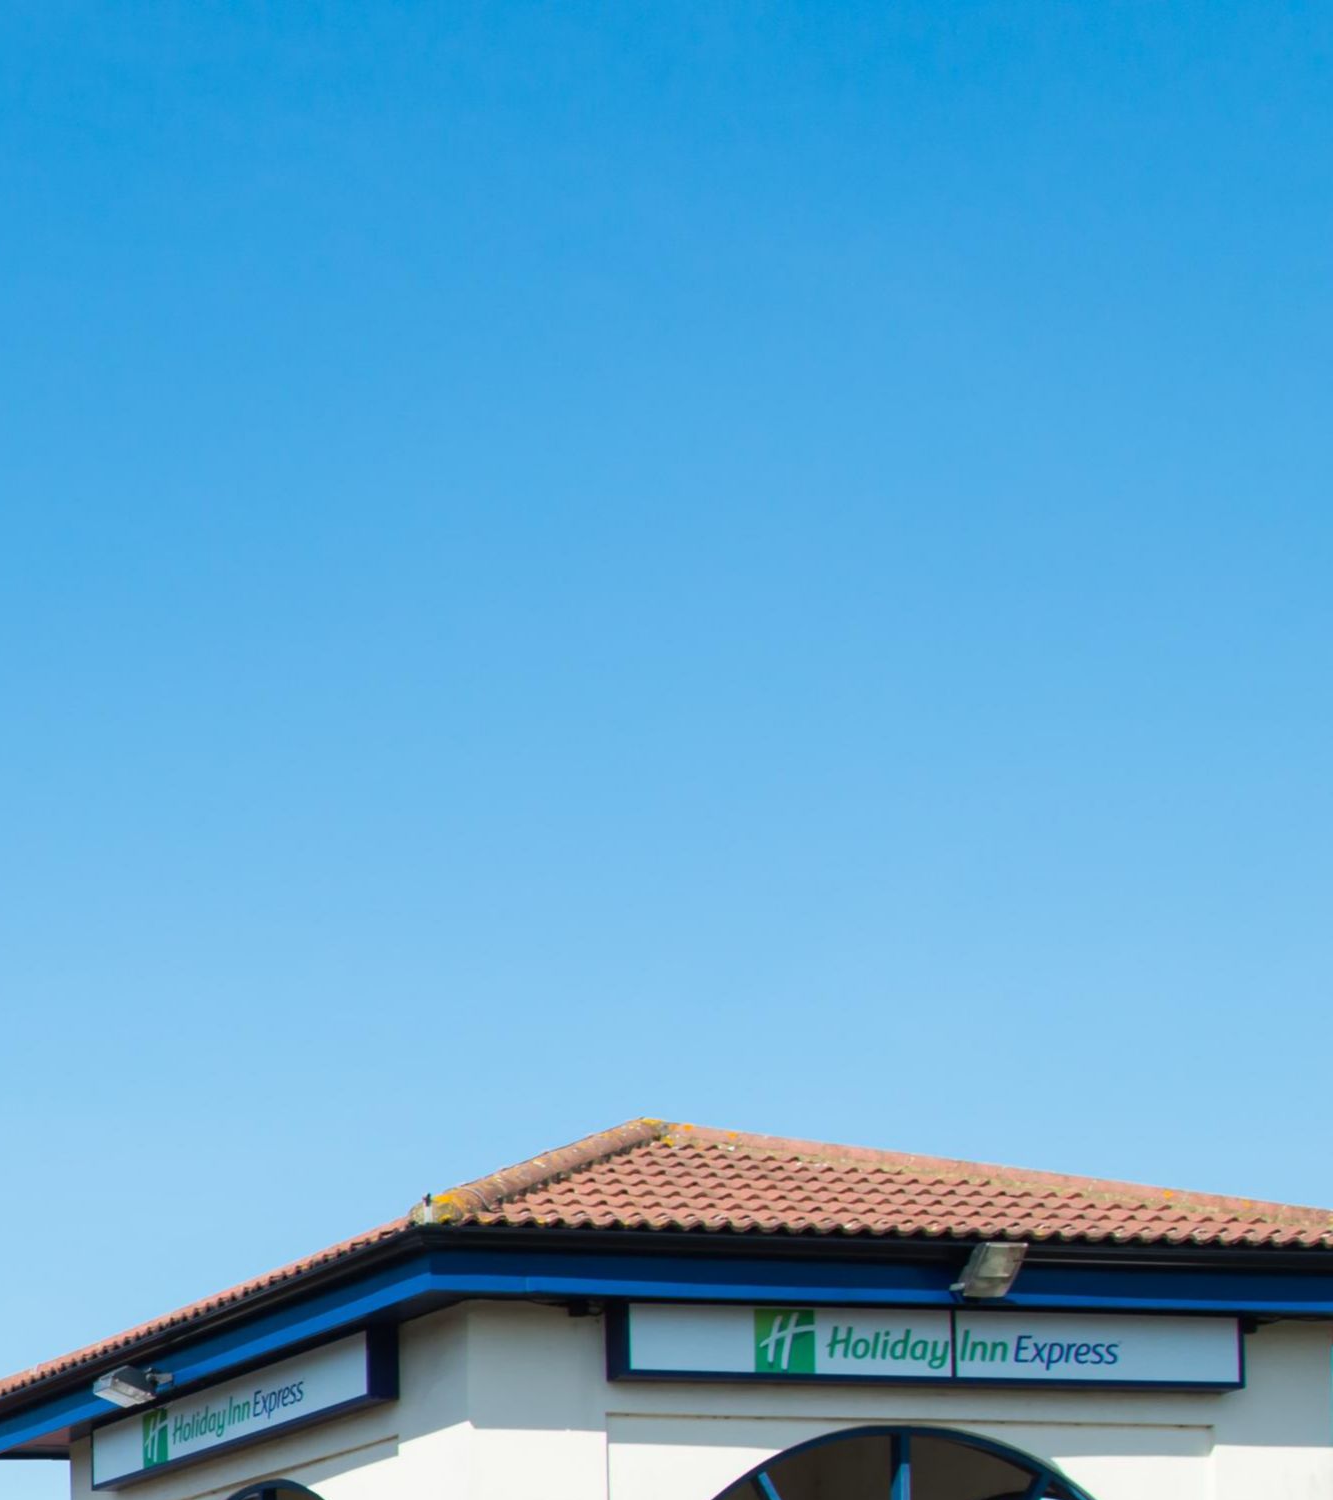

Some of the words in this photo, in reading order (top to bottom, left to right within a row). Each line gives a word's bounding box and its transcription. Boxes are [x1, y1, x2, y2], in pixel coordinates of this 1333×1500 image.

[825, 1326, 950, 1370] Holiday
[958, 1329, 1007, 1363] Inn
[1014, 1335, 1118, 1370] Express
[172, 1406, 227, 1445] Holiday
[228, 1396, 251, 1426] Inn
[253, 1381, 304, 1419] Express
